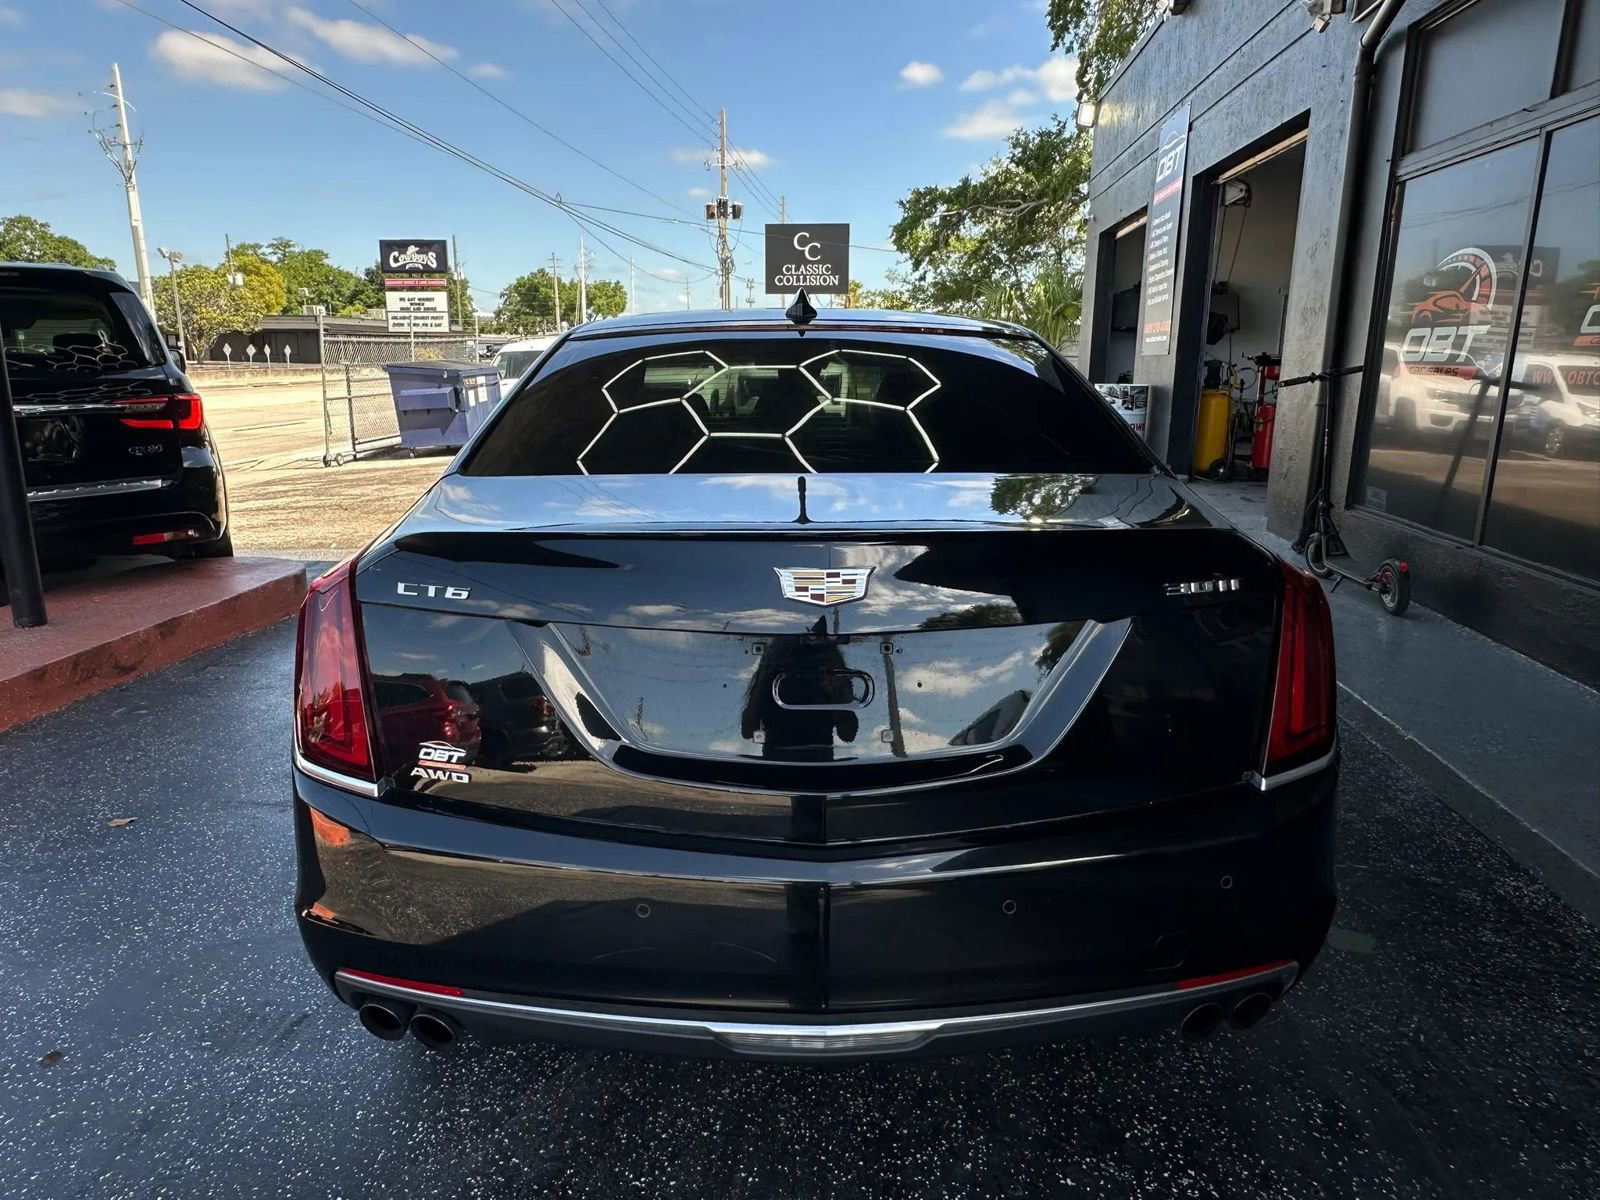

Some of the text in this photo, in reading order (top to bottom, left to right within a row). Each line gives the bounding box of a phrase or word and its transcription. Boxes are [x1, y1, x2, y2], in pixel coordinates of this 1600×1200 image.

[1156, 141, 1186, 183] OBT
[782, 264, 832, 275] CLASSIC
[774, 275, 839, 286] COLLISION
[1403, 325, 1491, 362] OBT
[397, 582, 472, 600] CT6
[418, 748, 466, 763] OBT
[410, 767, 469, 783] AWD
